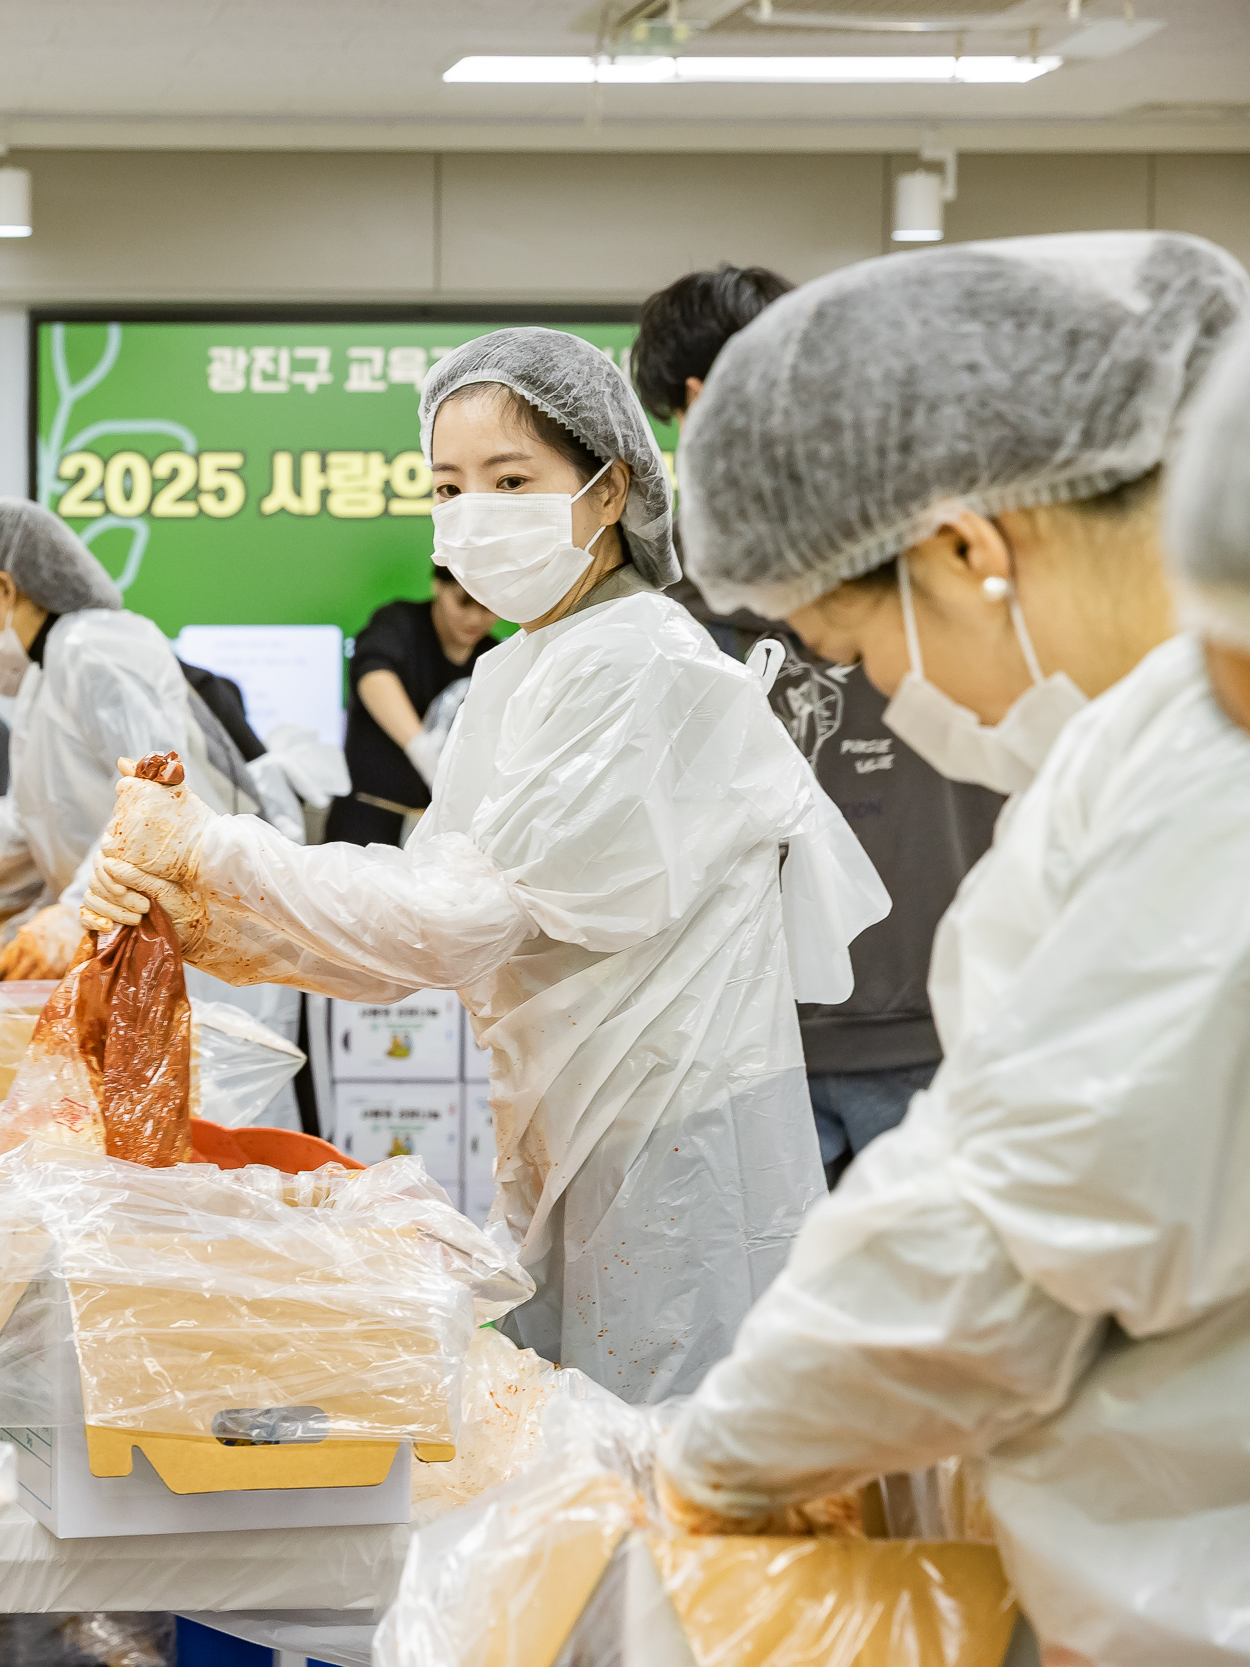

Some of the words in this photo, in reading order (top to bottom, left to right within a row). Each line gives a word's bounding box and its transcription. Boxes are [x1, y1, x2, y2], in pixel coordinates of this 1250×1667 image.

[207, 345, 333, 394] 광진구
[344, 345, 454, 394] 교육
[57, 450, 246, 519] 2025
